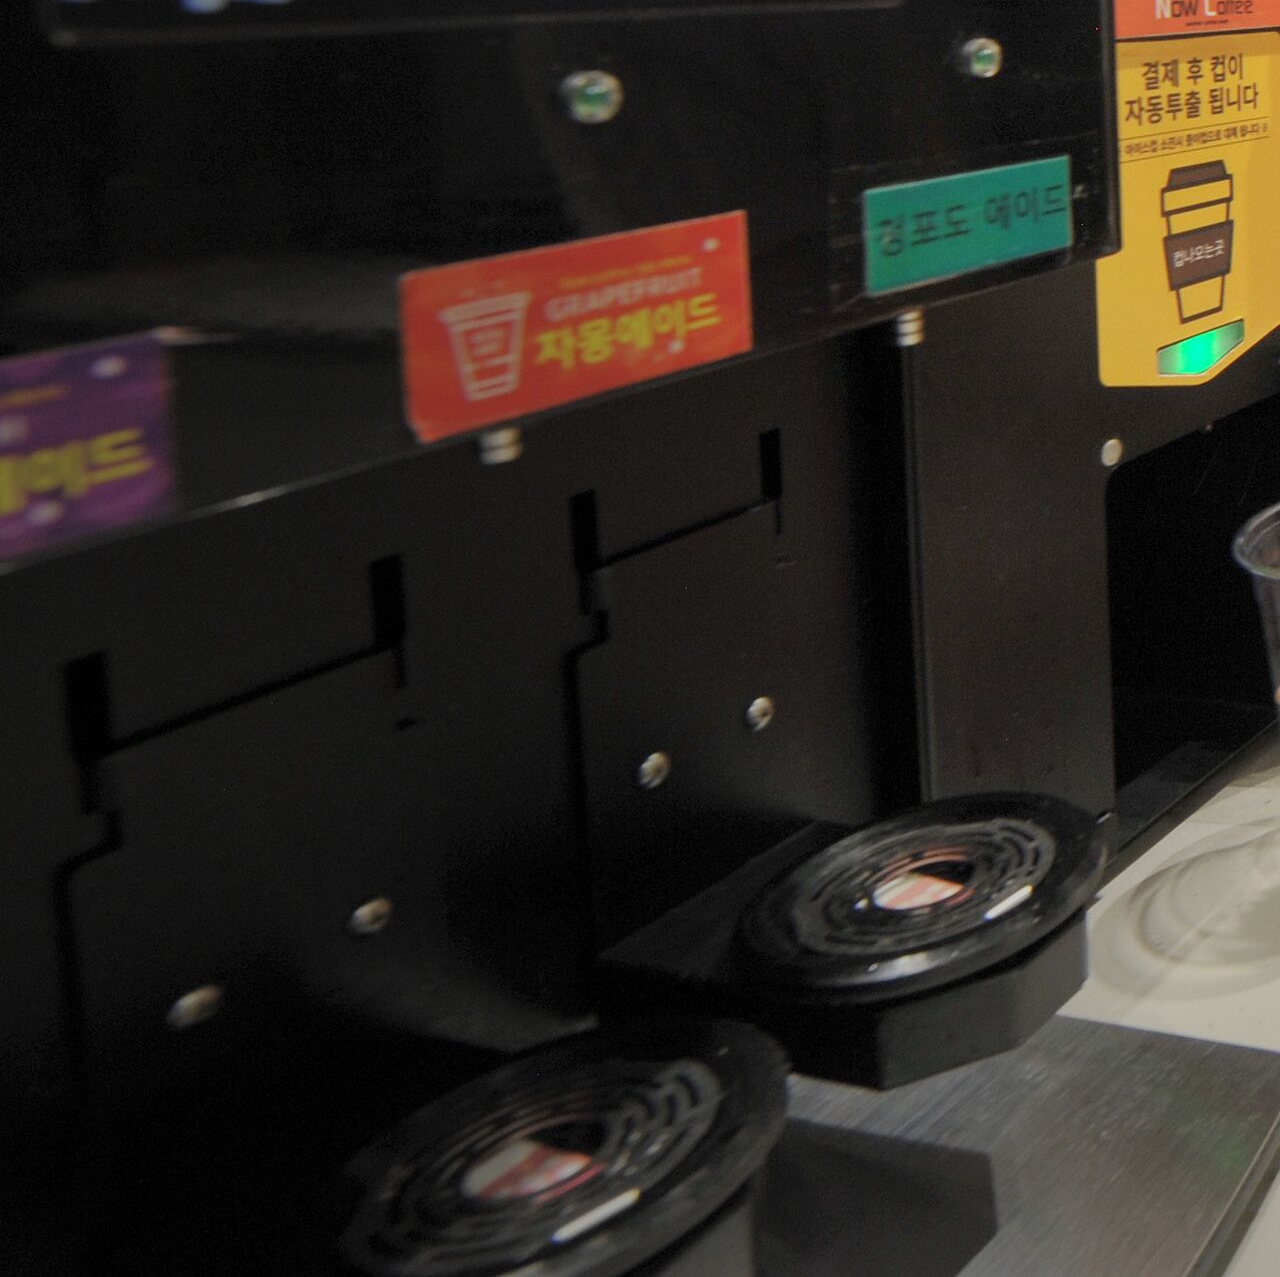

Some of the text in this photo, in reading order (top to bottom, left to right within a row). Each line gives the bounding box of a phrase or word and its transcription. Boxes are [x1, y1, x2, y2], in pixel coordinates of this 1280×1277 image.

[1143, 53, 1244, 91] 결제 후 컵이
[1125, 82, 1259, 127] 자동투출 됩니다
[876, 183, 1067, 258] 청포도 에이드
[1173, 238, 1226, 269] 컵나오는곳
